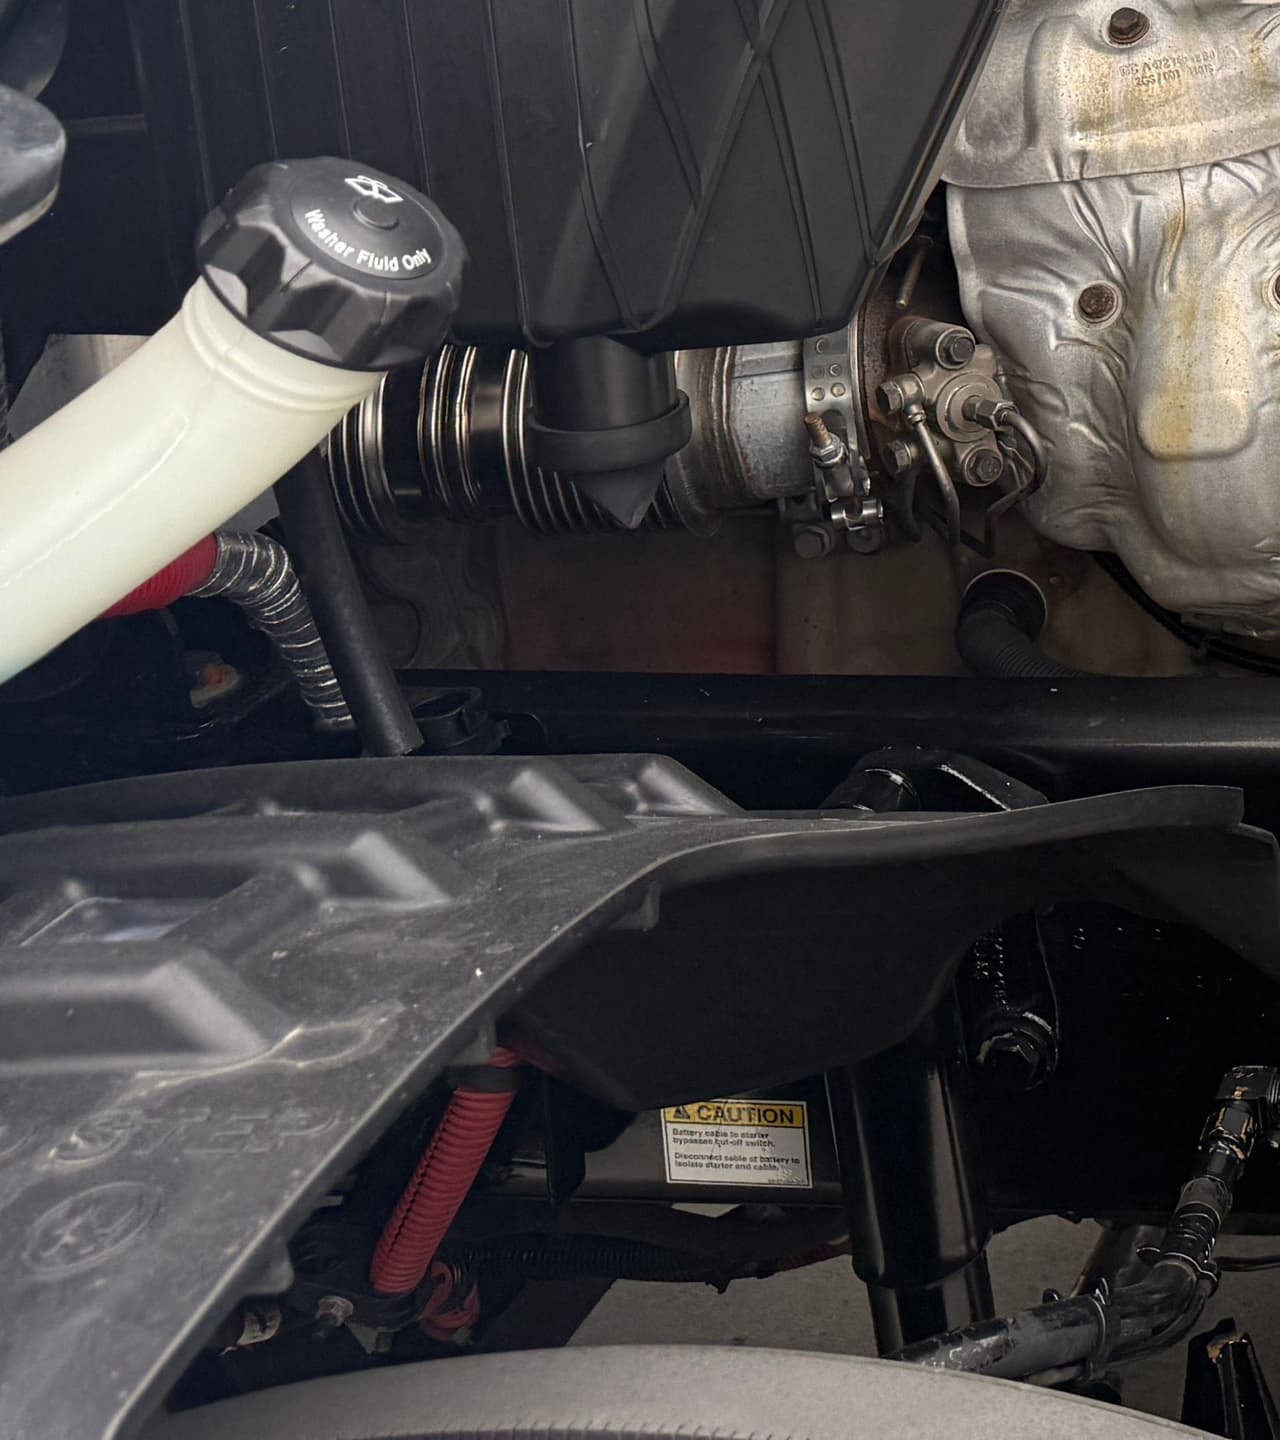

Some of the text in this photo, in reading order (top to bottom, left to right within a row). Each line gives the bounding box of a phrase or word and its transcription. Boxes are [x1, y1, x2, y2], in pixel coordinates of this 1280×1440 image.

[304, 208, 432, 273] Washer Fluid Only
[697, 1104, 794, 1125] CAUTION
[672, 1127, 769, 1139] Battery cable to starter
[672, 1136, 775, 1148] bypasses cut-off switch.
[674, 1152, 723, 1162] Disconnect
[724, 1154, 747, 1163] cable
[759, 1155, 789, 1166] battery
[791, 1157, 801, 1165] to
[705, 1161, 733, 1170] starter
[735, 1162, 752, 1170] and
